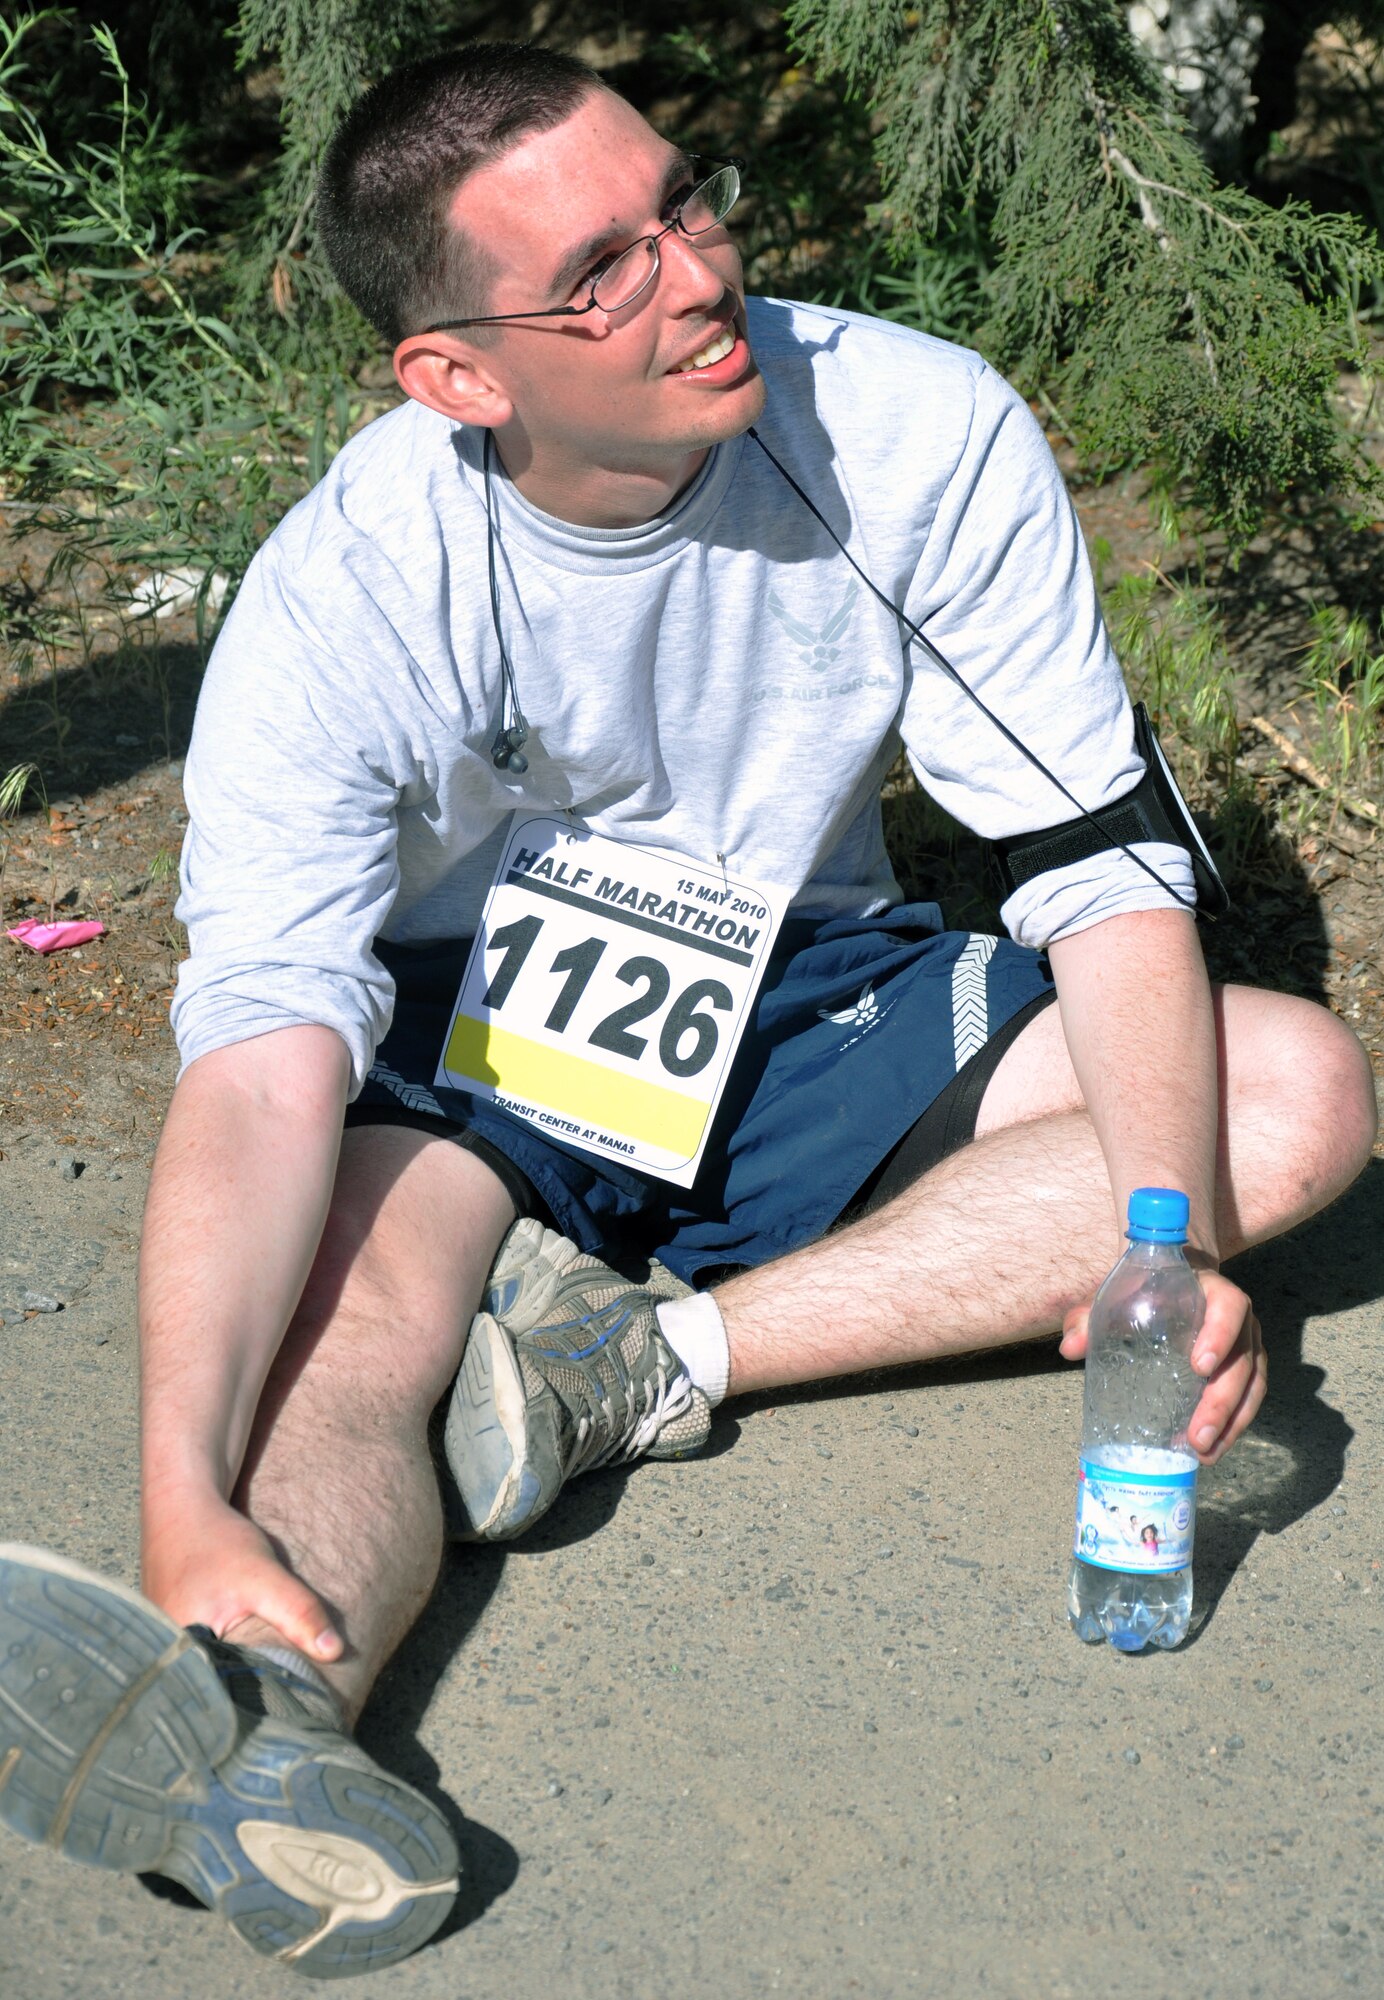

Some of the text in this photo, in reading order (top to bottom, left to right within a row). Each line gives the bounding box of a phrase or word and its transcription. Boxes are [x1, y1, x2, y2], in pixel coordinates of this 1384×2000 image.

[791, 687, 821, 701] AIR
[826, 674, 892, 699] FORCE
[512, 847, 761, 950] HALF MARATHON
[677, 879, 767, 920] 15 MAY 2010
[480, 913, 734, 1078] 1126
[491, 1094, 636, 1155] TRANSIT CENTER AT MANAS
